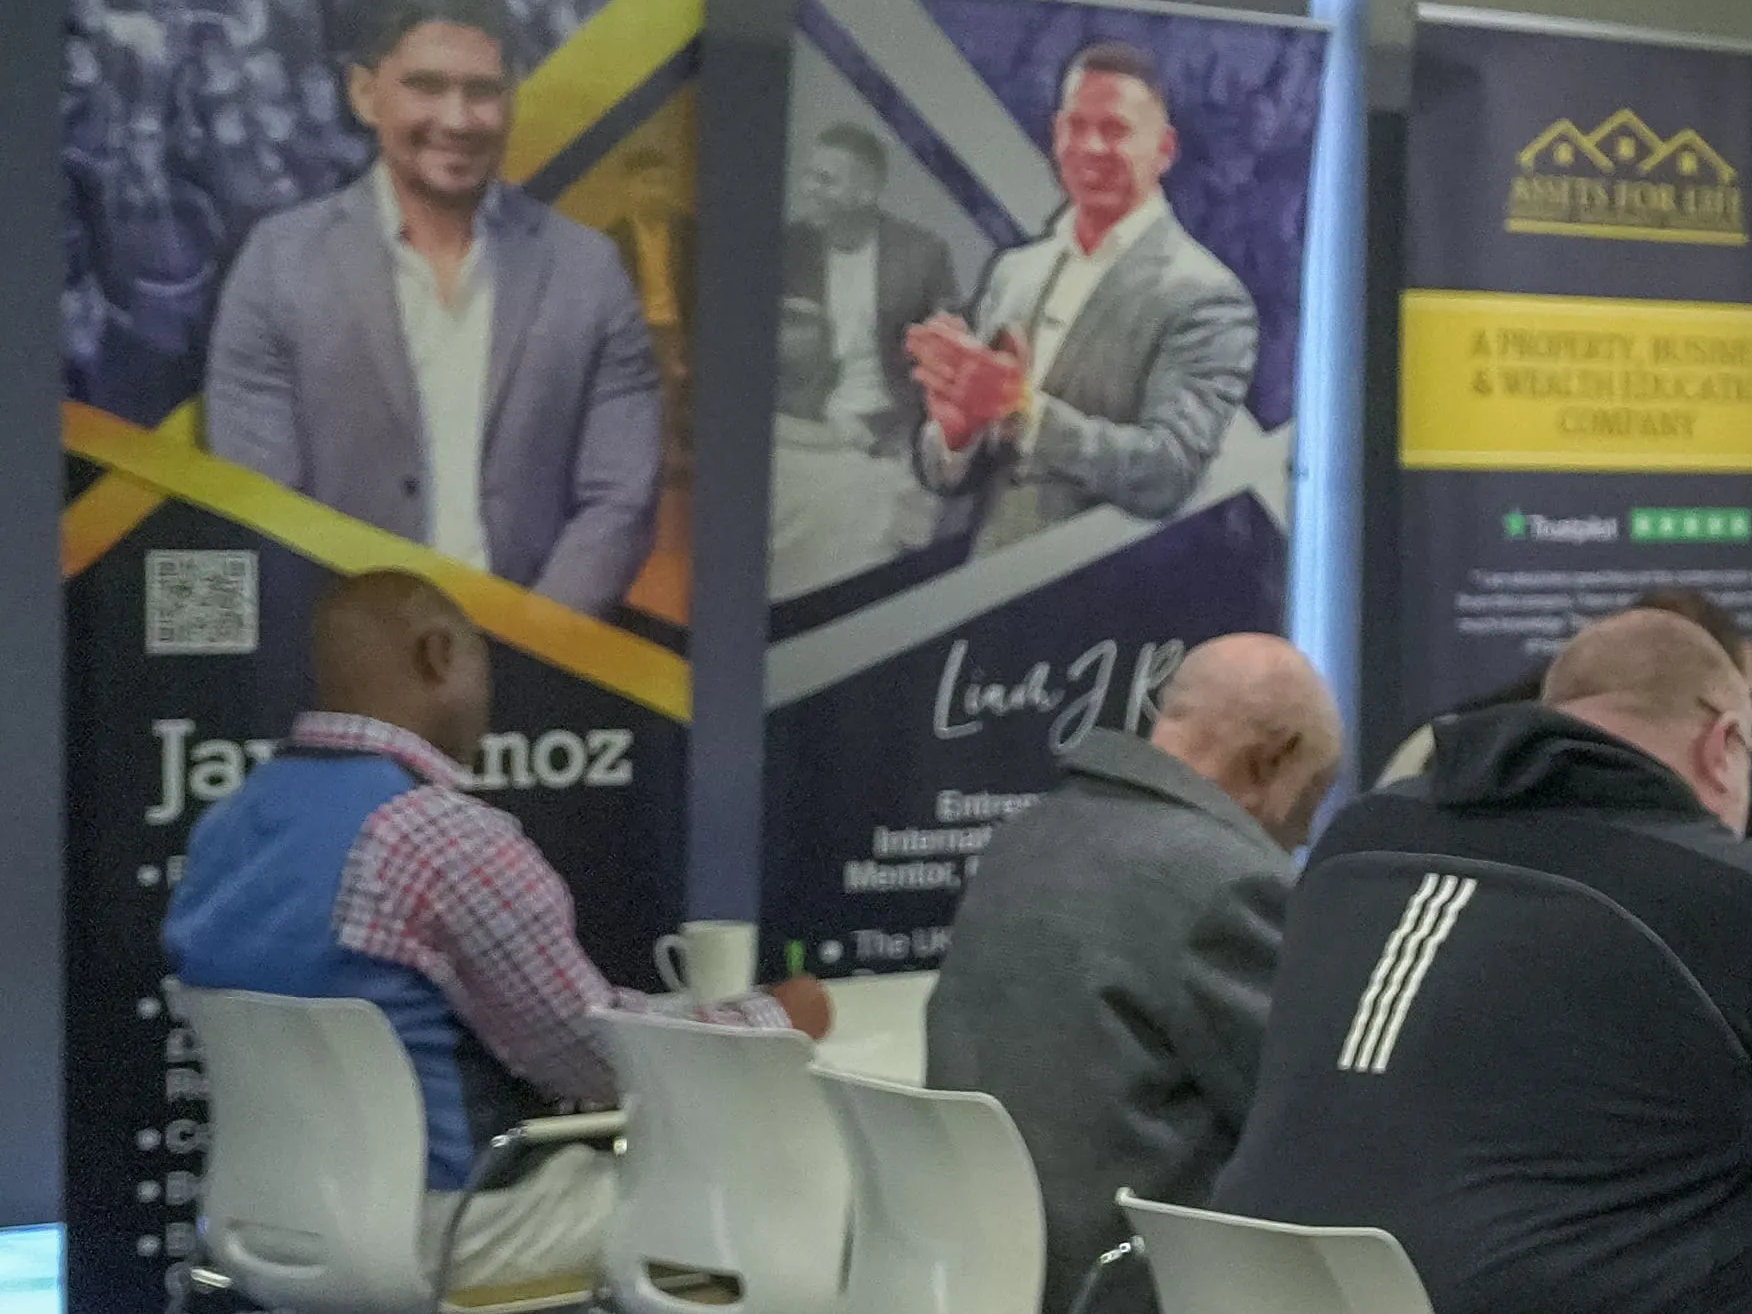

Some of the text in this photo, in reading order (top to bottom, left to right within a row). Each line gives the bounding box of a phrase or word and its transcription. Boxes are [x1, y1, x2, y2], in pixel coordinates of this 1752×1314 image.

[1472, 328, 1491, 357] A
[1558, 405, 1696, 437] COMPANY
[476, 728, 633, 789] noz
